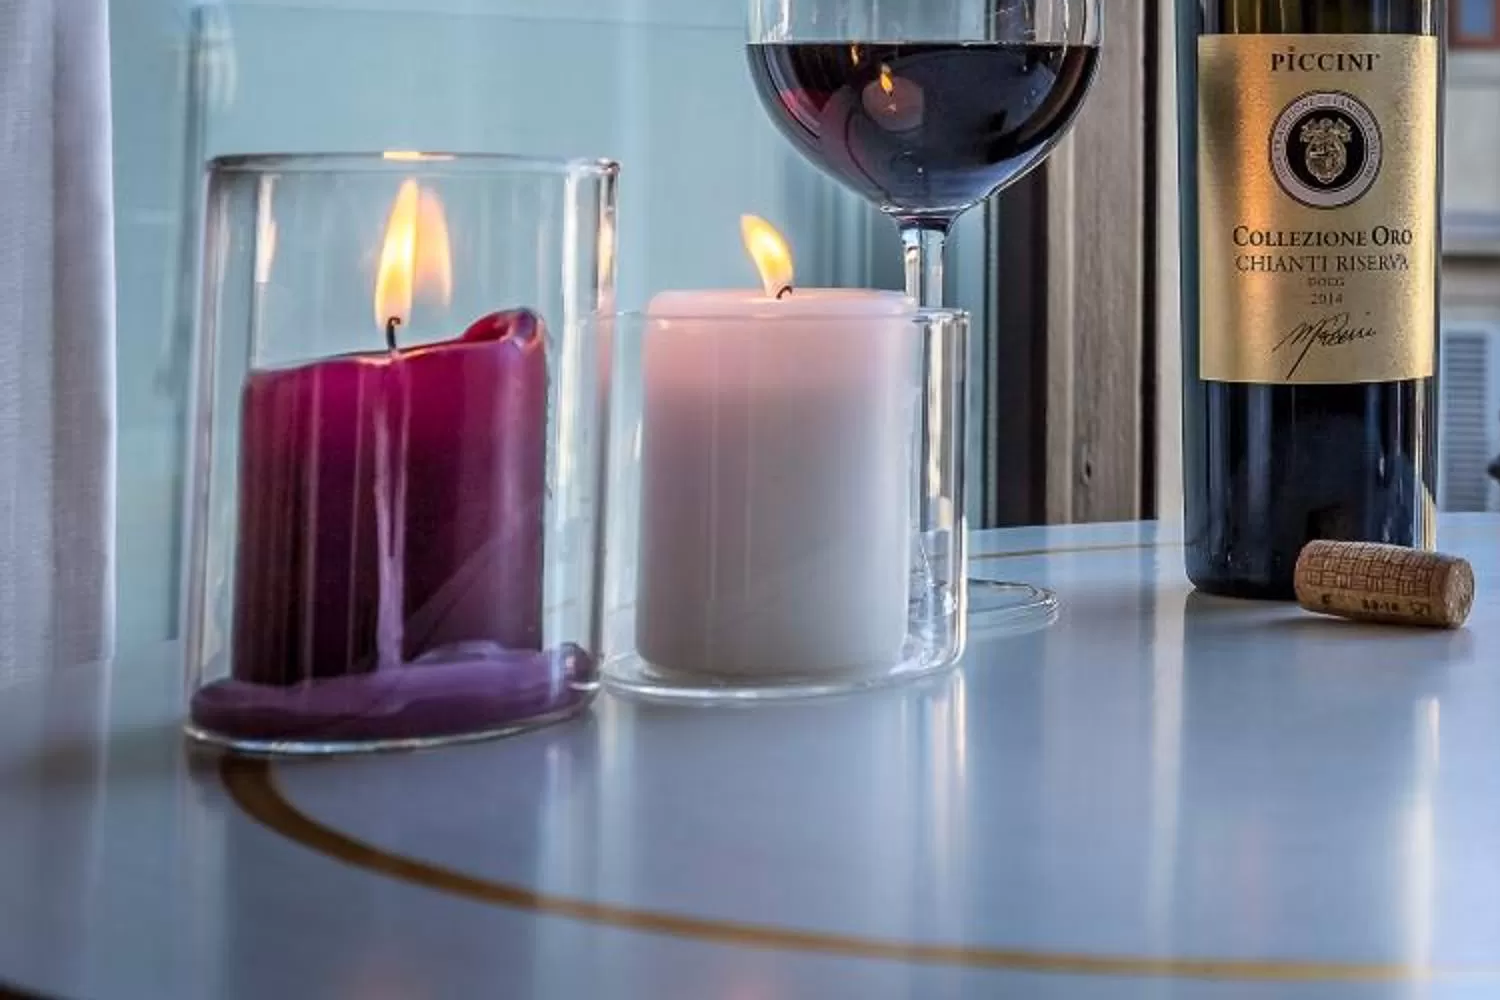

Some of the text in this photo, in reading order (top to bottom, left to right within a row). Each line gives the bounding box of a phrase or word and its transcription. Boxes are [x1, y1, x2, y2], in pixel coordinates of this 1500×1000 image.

[1232, 225, 1413, 247] COLLEZIONE ORO
[1235, 252, 1409, 273] CHIANTI RISERVA
